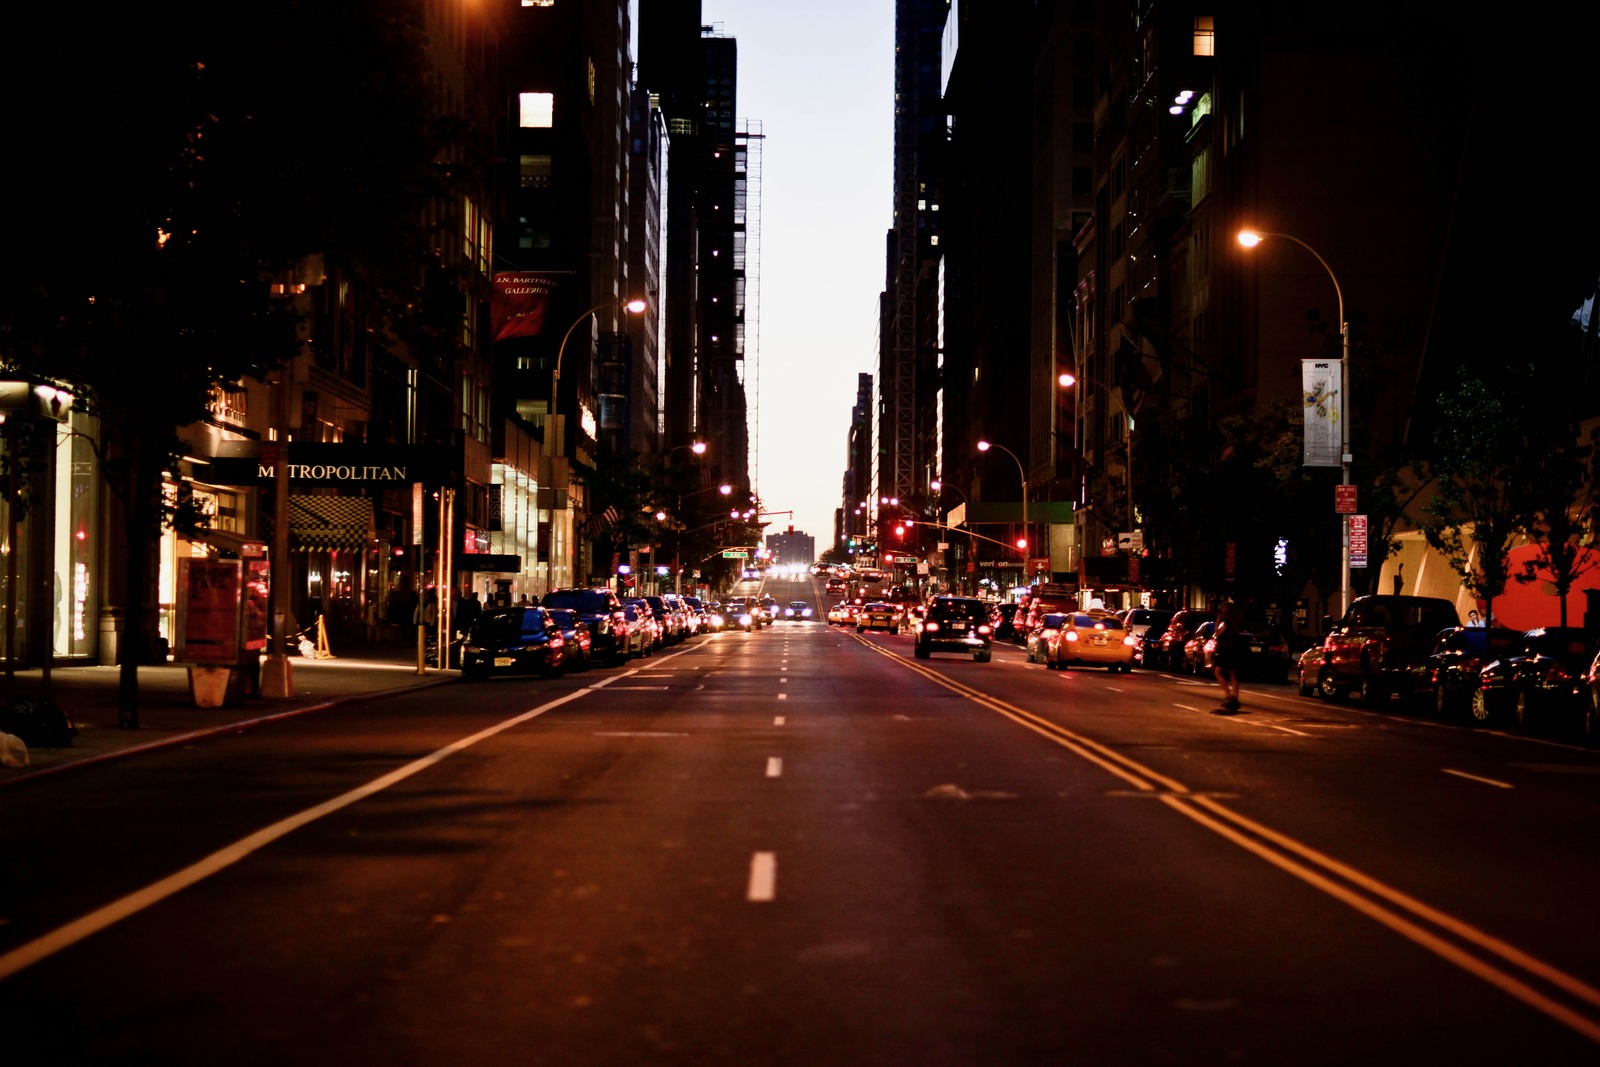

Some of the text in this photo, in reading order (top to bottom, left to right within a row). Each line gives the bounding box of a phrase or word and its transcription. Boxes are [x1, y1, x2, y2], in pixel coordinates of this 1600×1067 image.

[505, 287, 549, 295] GALLERIES
[257, 464, 407, 481] MTROPOLITAN
[489, 489, 501, 519] ROSSI
[979, 560, 1008, 568] verion
[1293, 608, 1307, 618] ARK
